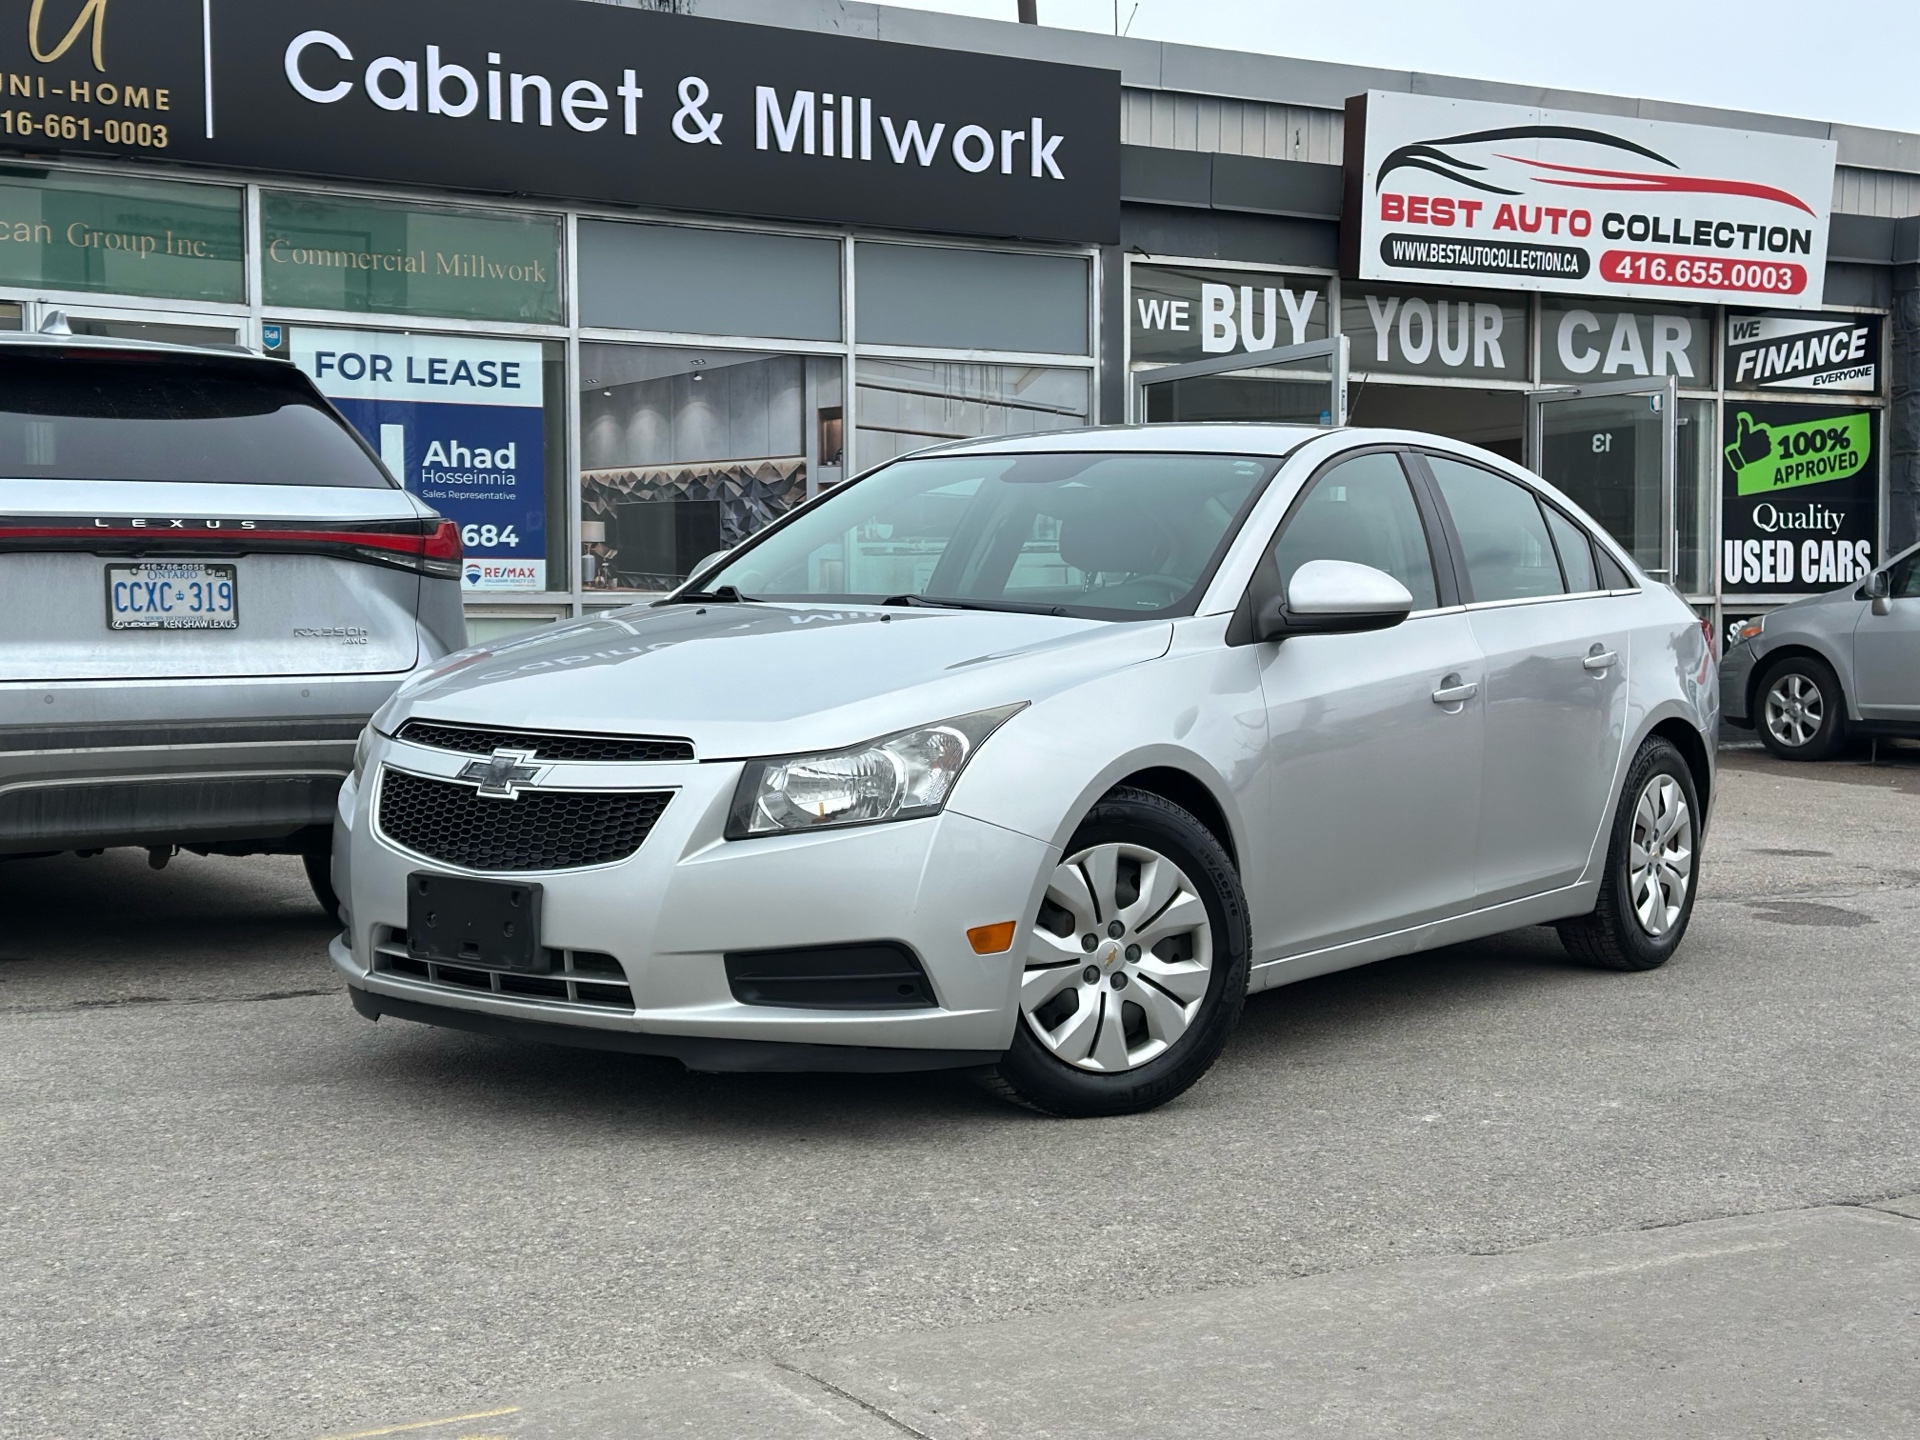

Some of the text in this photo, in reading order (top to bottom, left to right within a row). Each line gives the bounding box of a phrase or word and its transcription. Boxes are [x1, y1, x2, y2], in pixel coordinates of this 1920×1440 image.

[0, 72, 170, 111] NI-HOME
[284, 29, 1065, 180] Cabinet & Millwork
[1380, 193, 1813, 255] BEST AUTO COLLECTION
[66, 222, 156, 259] Group
[166, 230, 215, 258] Inc.
[1391, 240, 1580, 273] WWW.BESTAUTOCOLLECTION.CA
[269, 238, 546, 283] Commercial Millwork
[1615, 255, 1793, 290] 416.655.0003
[1137, 283, 1695, 378] WE BUY YOUR CAR
[1733, 320, 1761, 341] WE
[315, 351, 521, 389] FOR LEASE
[1736, 327, 1869, 383] FINANCE
[1812, 366, 1873, 386] EVERYONE
[422, 440, 516, 470] Ahad
[1777, 426, 1851, 460] 100%
[421, 469, 516, 486] Hosseinnia
[1772, 450, 1859, 487] APPROVED
[422, 489, 516, 501] Sales Representative
[95, 518, 255, 530] LEXUS
[1752, 503, 1846, 535] Quality
[461, 524, 519, 548] 684
[147, 570, 198, 580] ONTARIO
[484, 567, 535, 578] RE/MAX
[1724, 539, 1872, 584] USED CARS
[114, 582, 231, 612] CCXC 319
[209, 620, 237, 628] LEXUS
[342, 637, 368, 645] AWD
